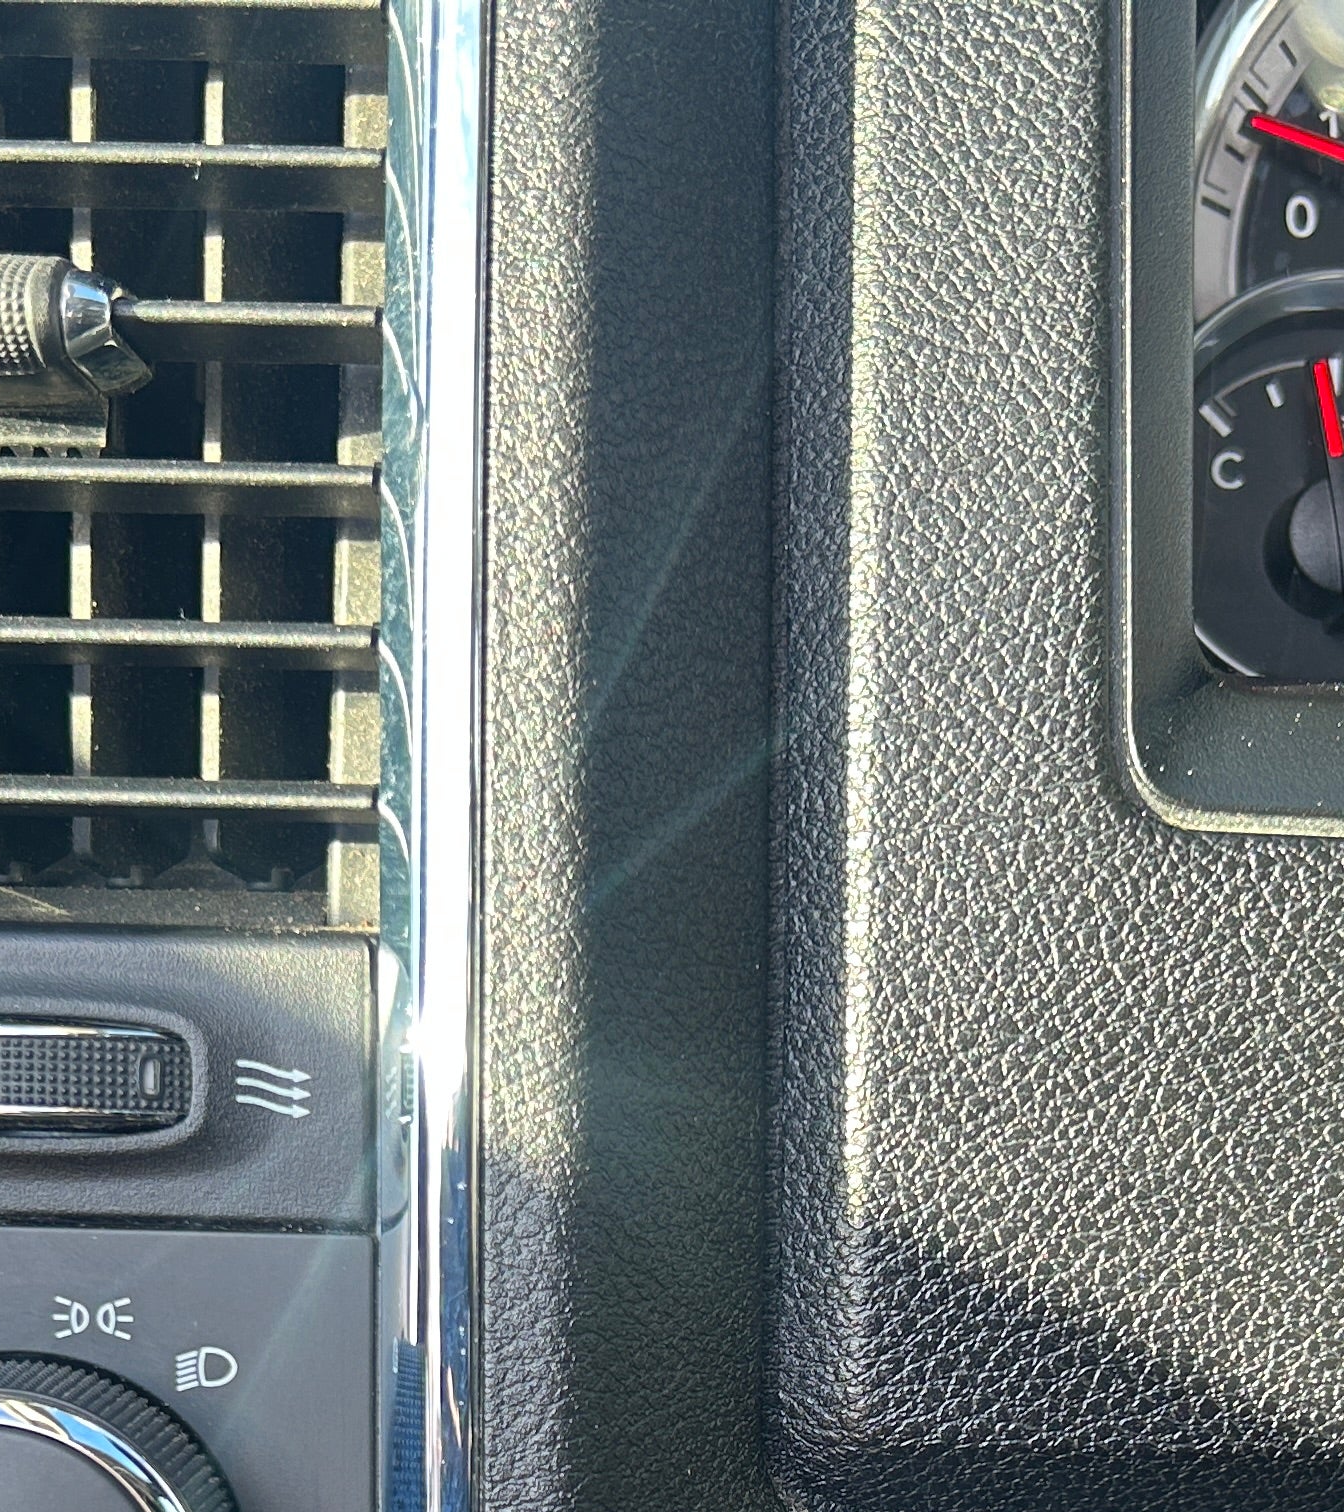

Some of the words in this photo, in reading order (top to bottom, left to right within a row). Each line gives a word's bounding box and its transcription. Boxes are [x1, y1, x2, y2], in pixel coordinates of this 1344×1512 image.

[1318, 110, 1340, 139] 1
[1285, 194, 1318, 239] 0
[1210, 450, 1244, 490] C
